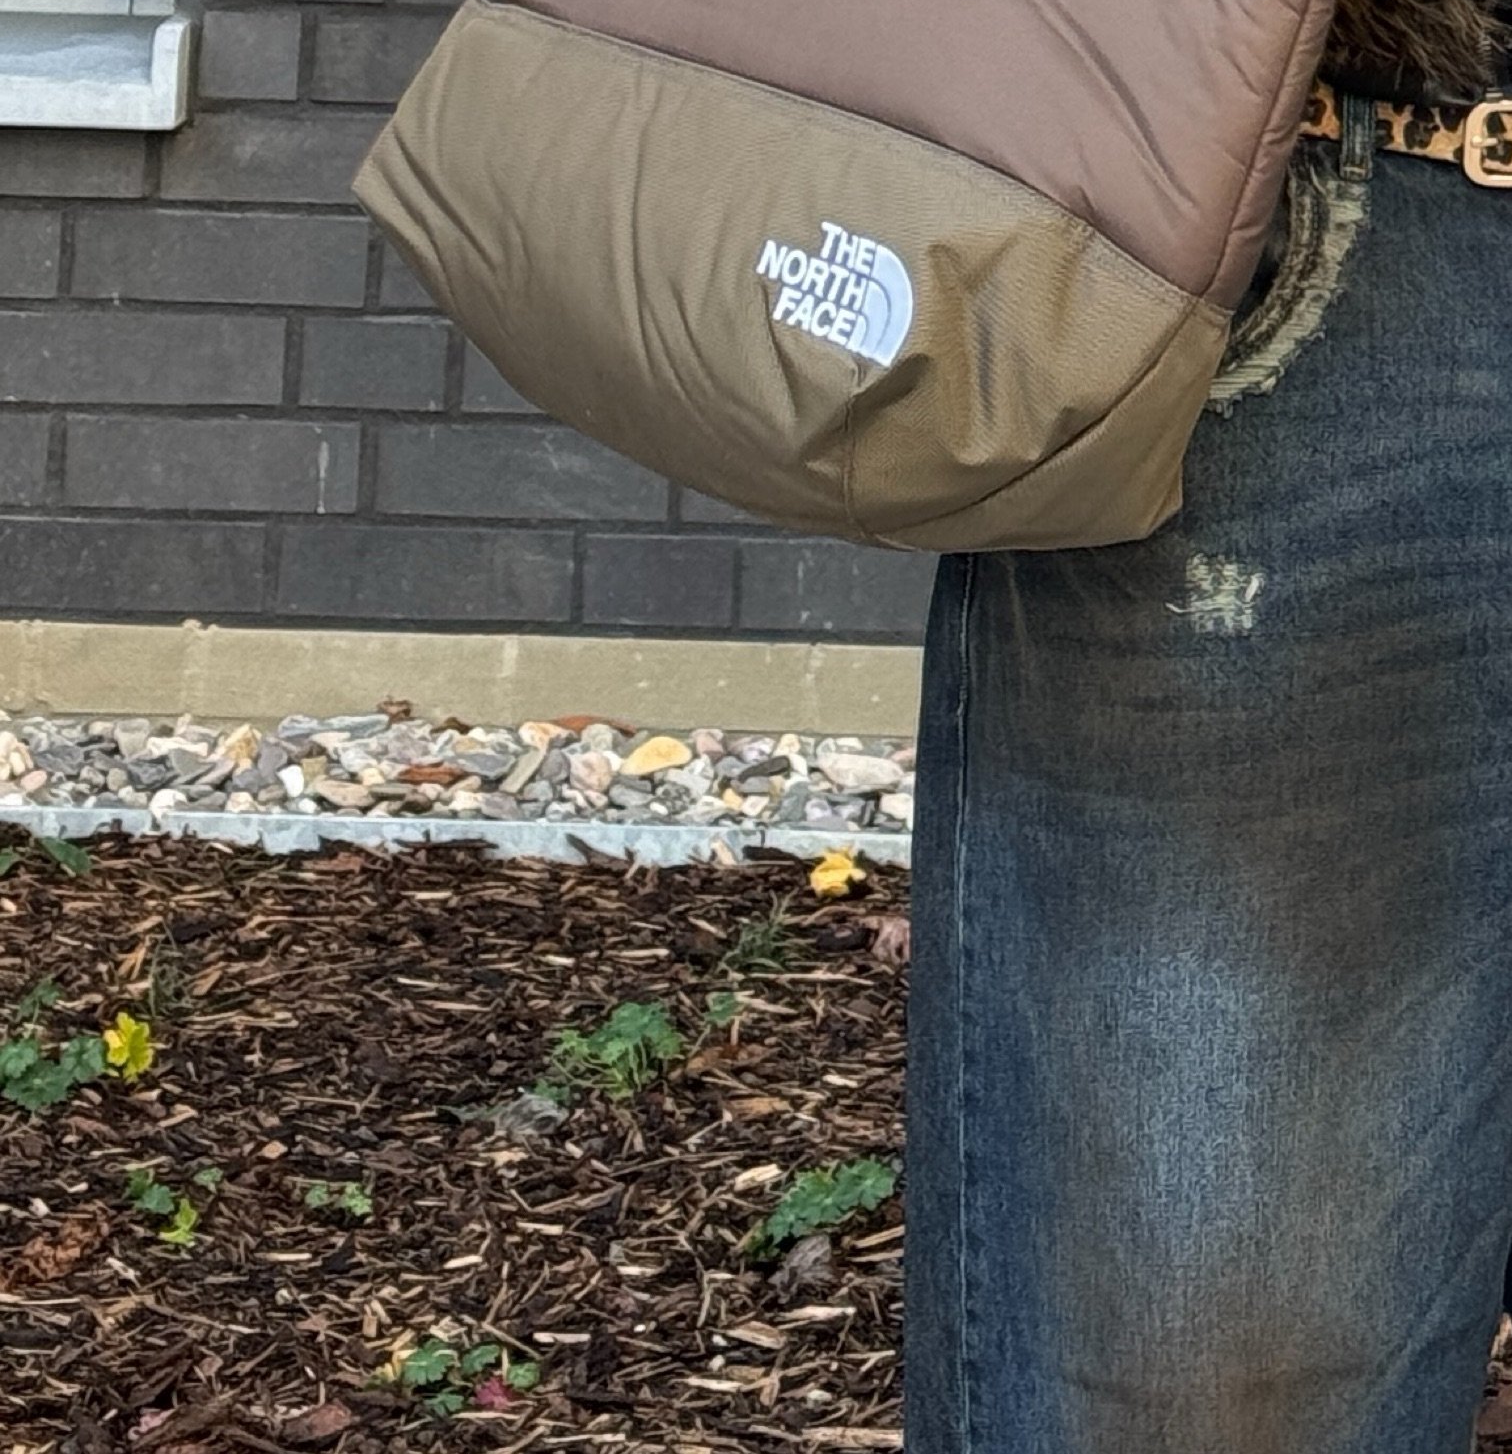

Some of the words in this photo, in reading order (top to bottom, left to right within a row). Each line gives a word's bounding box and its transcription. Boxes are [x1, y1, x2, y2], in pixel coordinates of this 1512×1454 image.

[756, 240, 867, 310] NORTH
[820, 220, 877, 275] THE
[773, 286, 856, 346] FACE
